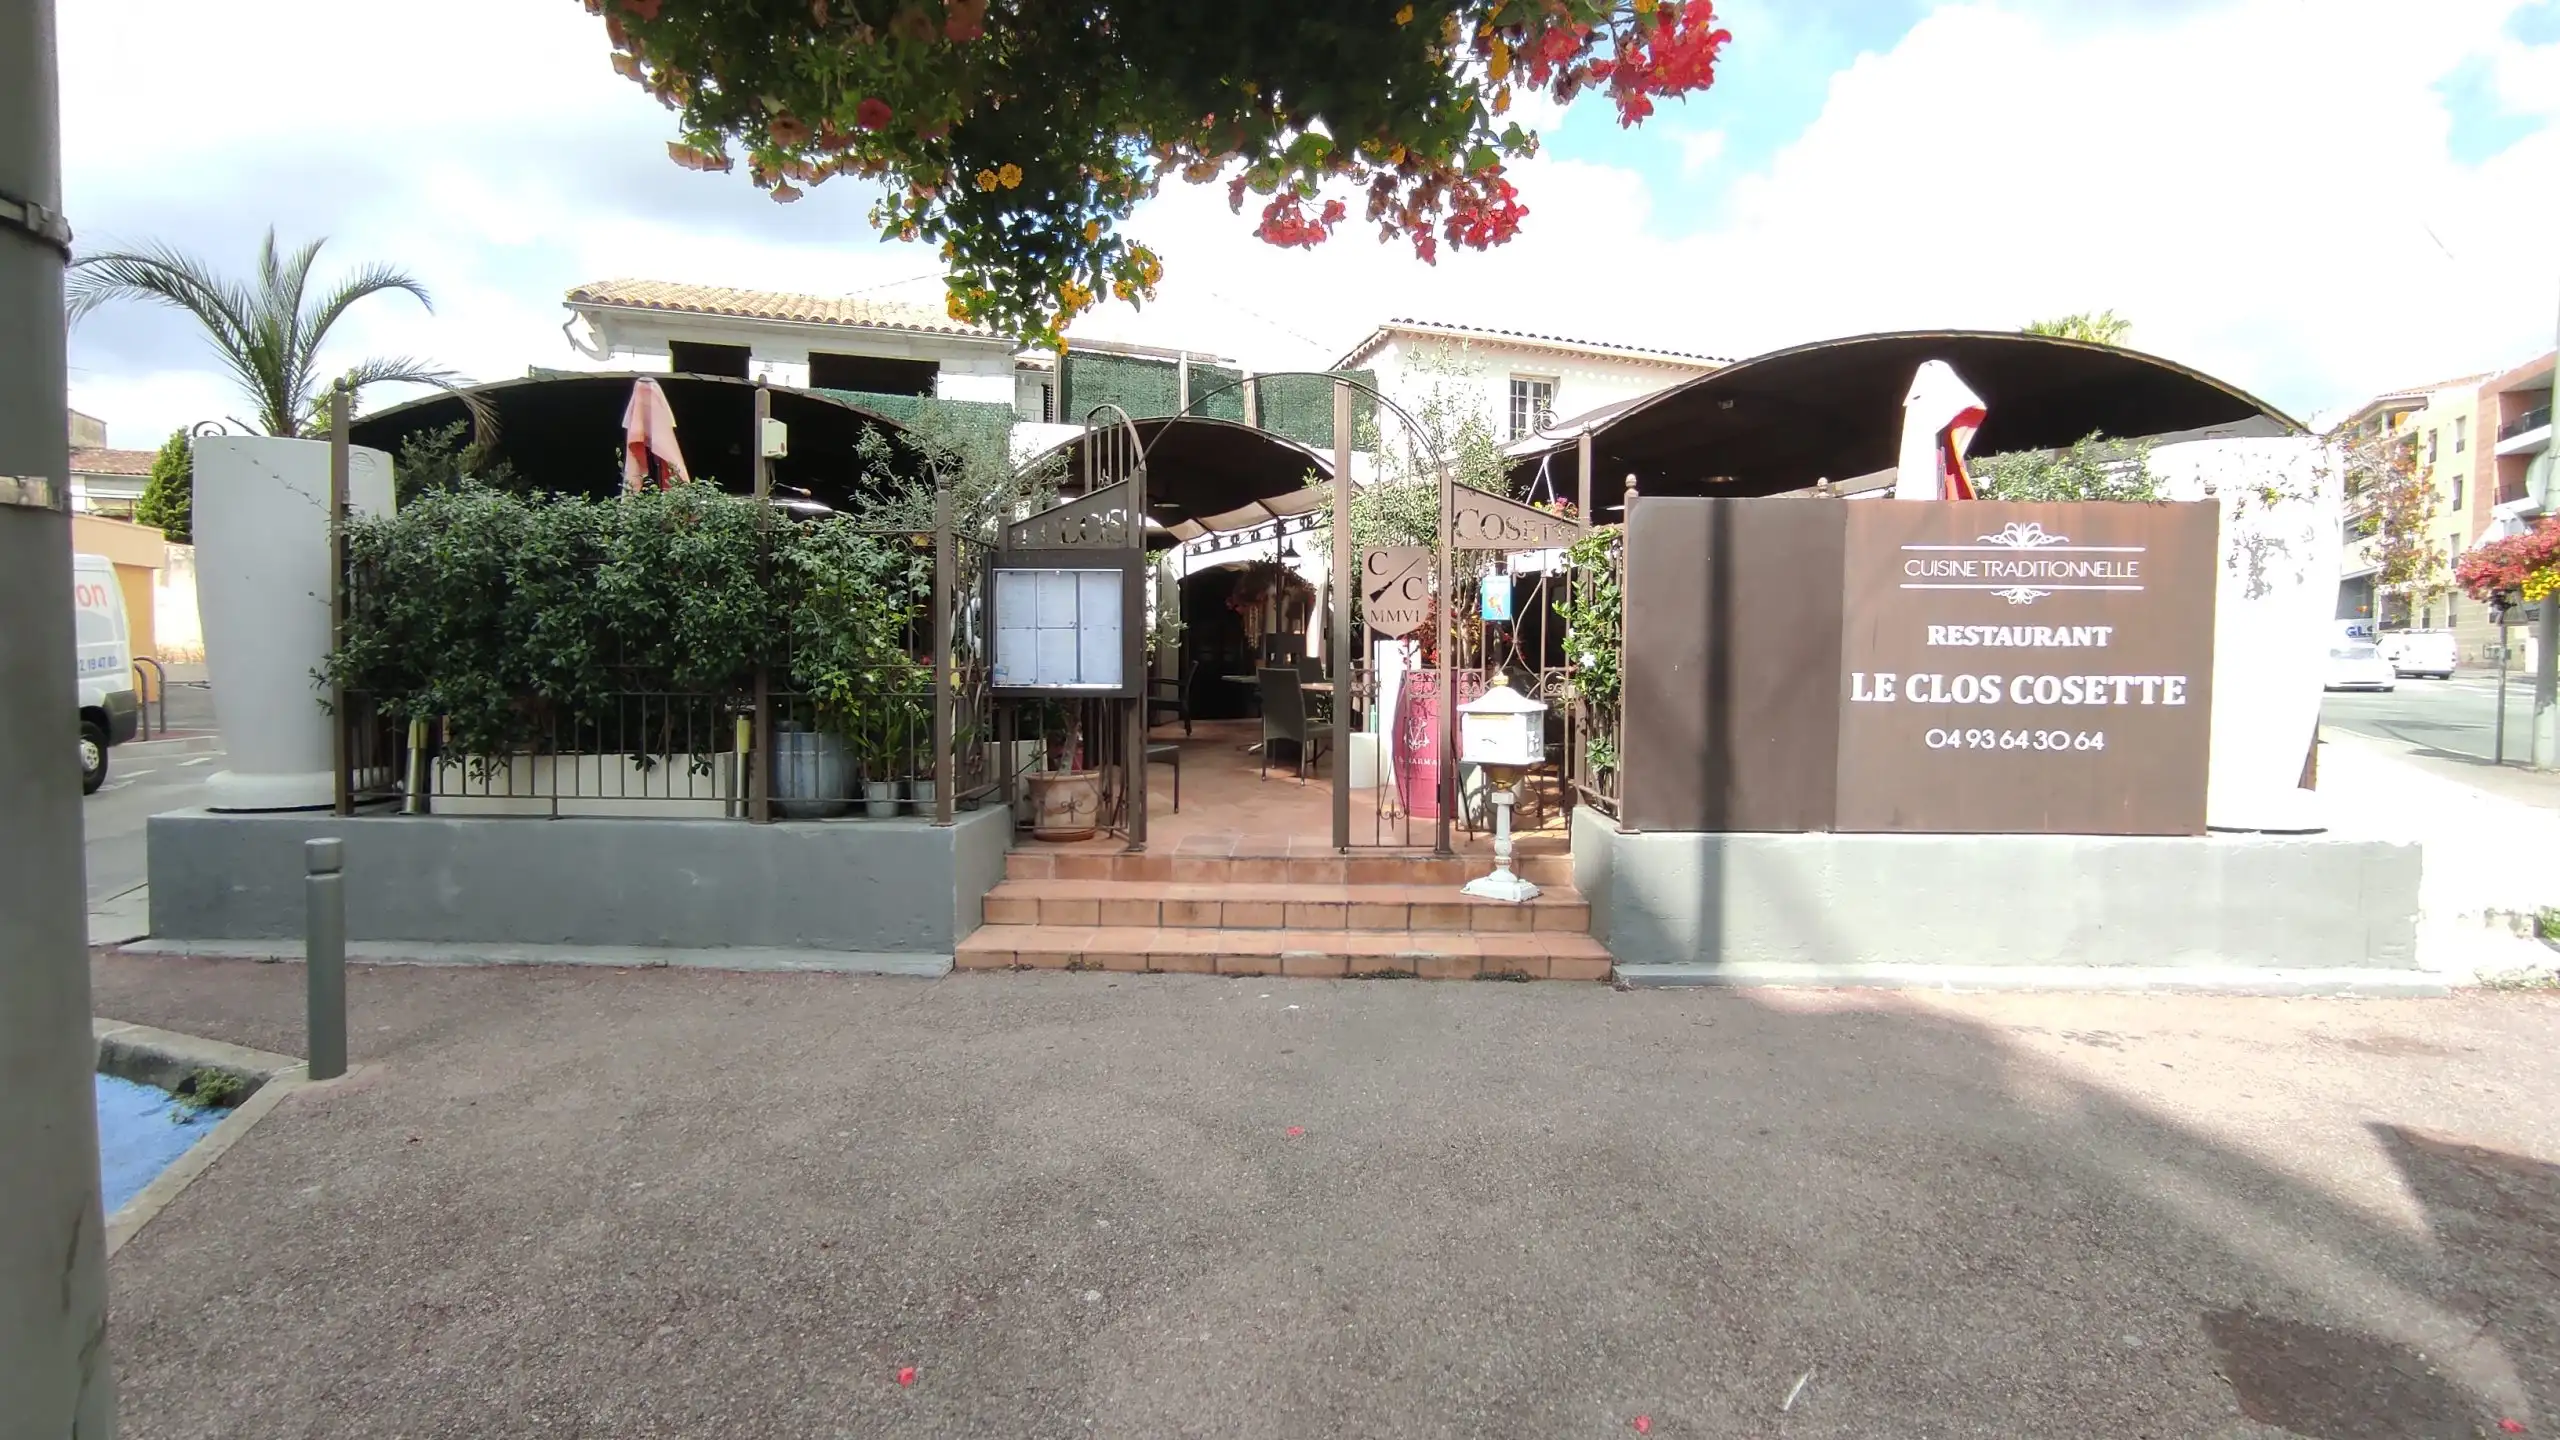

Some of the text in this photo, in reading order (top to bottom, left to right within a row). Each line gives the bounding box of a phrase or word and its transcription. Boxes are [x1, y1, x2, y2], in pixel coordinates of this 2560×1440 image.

[1904, 559, 2140, 578] CUISINE TRADITIONNELLE
[1370, 609, 1419, 623] MMVI
[1926, 625, 2113, 647] RESTAURANT
[1850, 672, 2187, 705] LE CLOS COSETTE
[1925, 728, 2105, 751] 04 93 64 30 64
